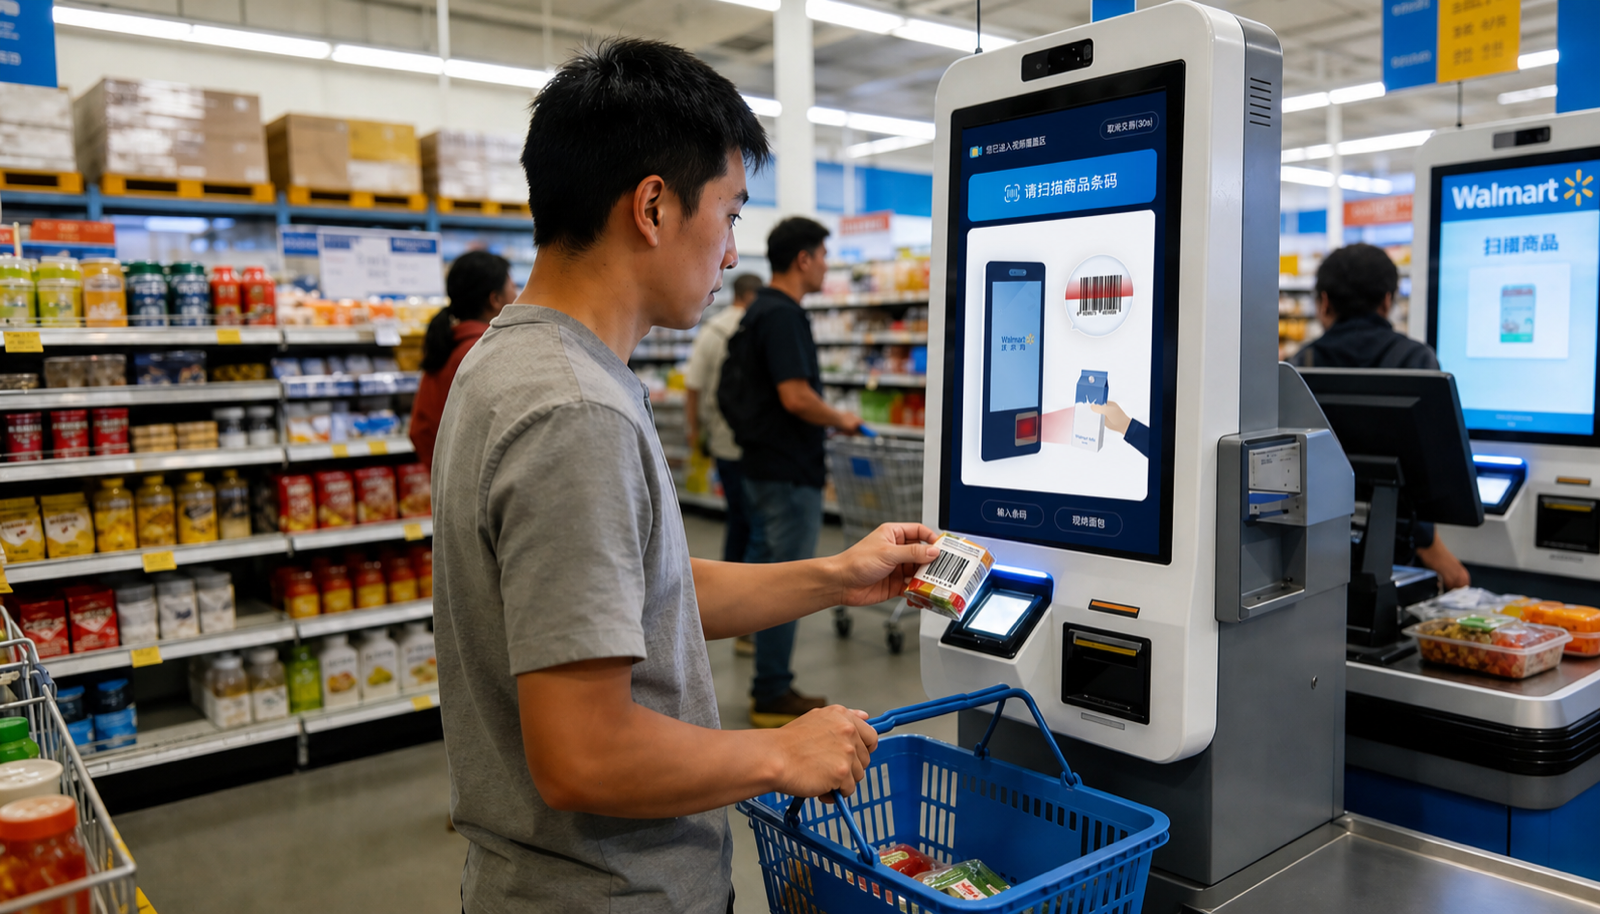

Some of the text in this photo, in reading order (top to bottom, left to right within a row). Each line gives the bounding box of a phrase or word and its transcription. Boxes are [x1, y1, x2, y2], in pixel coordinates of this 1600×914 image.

[1025, 172, 1118, 199] 请扫描商品条码
[1452, 178, 1559, 210] Walmart
